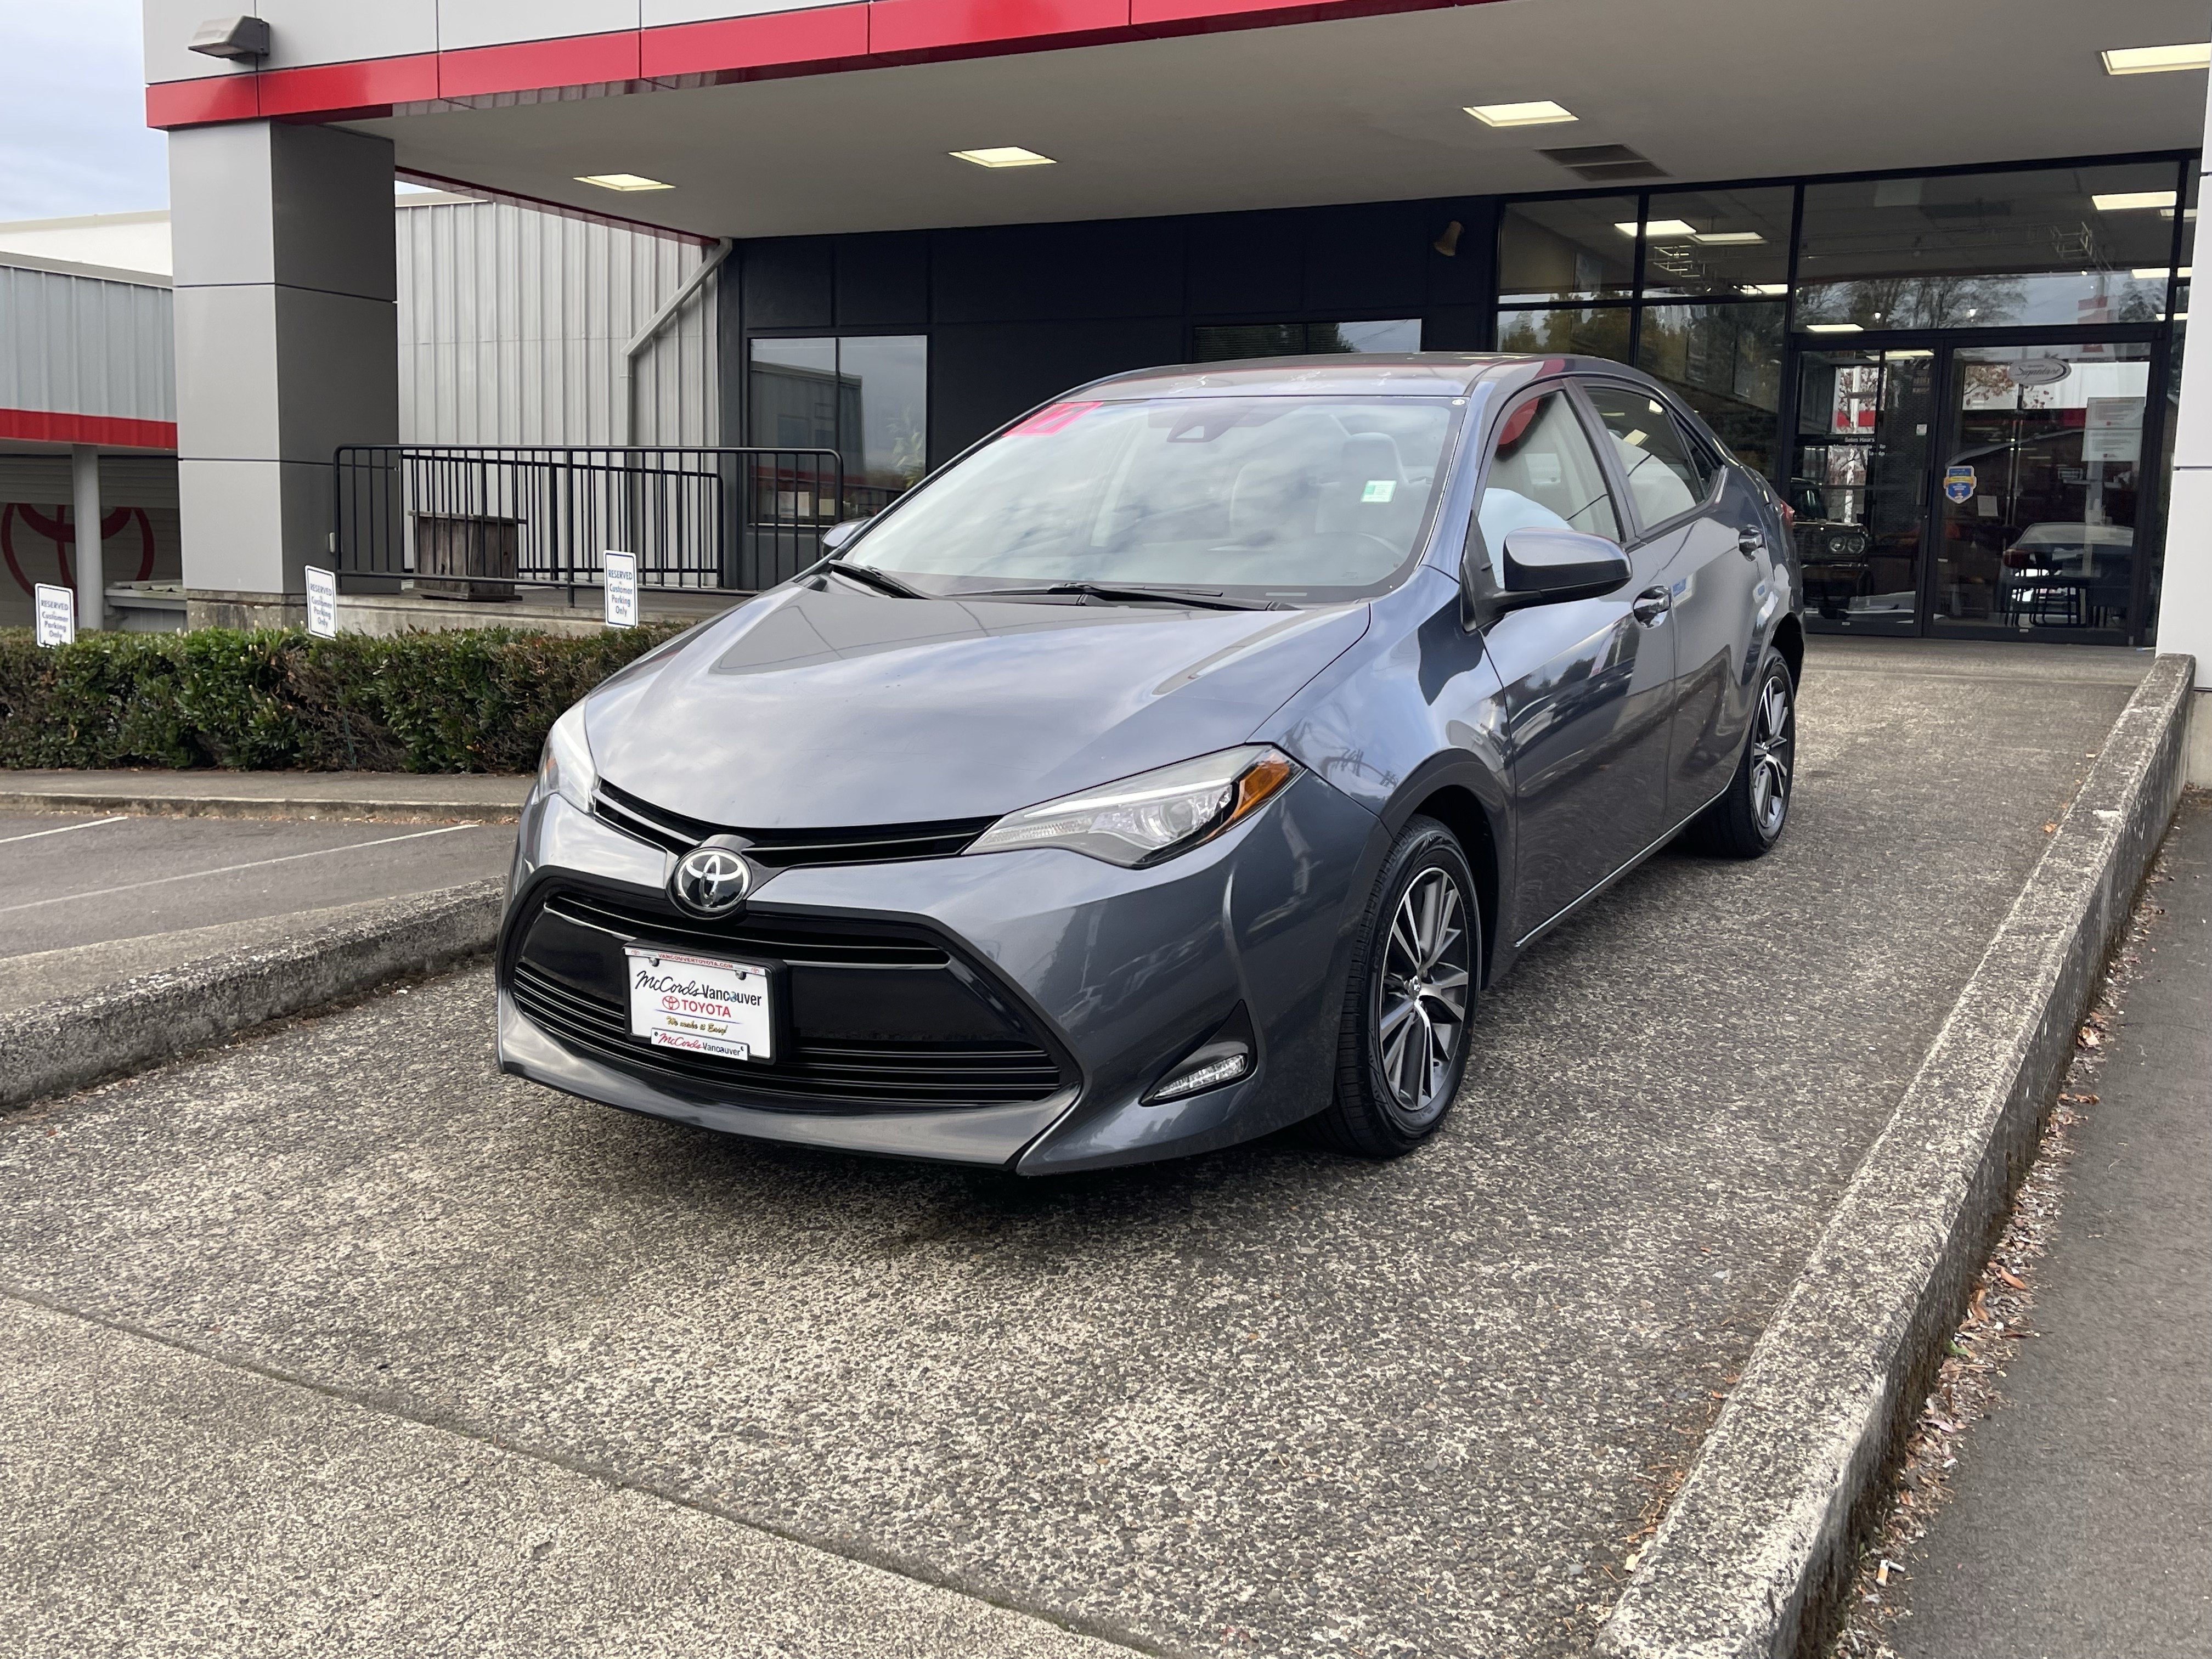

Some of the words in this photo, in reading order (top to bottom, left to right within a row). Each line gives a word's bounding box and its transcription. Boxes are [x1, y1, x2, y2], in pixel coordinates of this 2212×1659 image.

[608, 569, 633, 580] RESERVED
[310, 583, 332, 596] RESERVED
[609, 583, 633, 595] Customer
[41, 600, 68, 611] RESERVED
[611, 594, 630, 607] Parking
[615, 605, 627, 617] Only
[658, 953, 734, 969] VANCOUVERTOYOTA.COM
[681, 999, 732, 1018] TOYOTA
